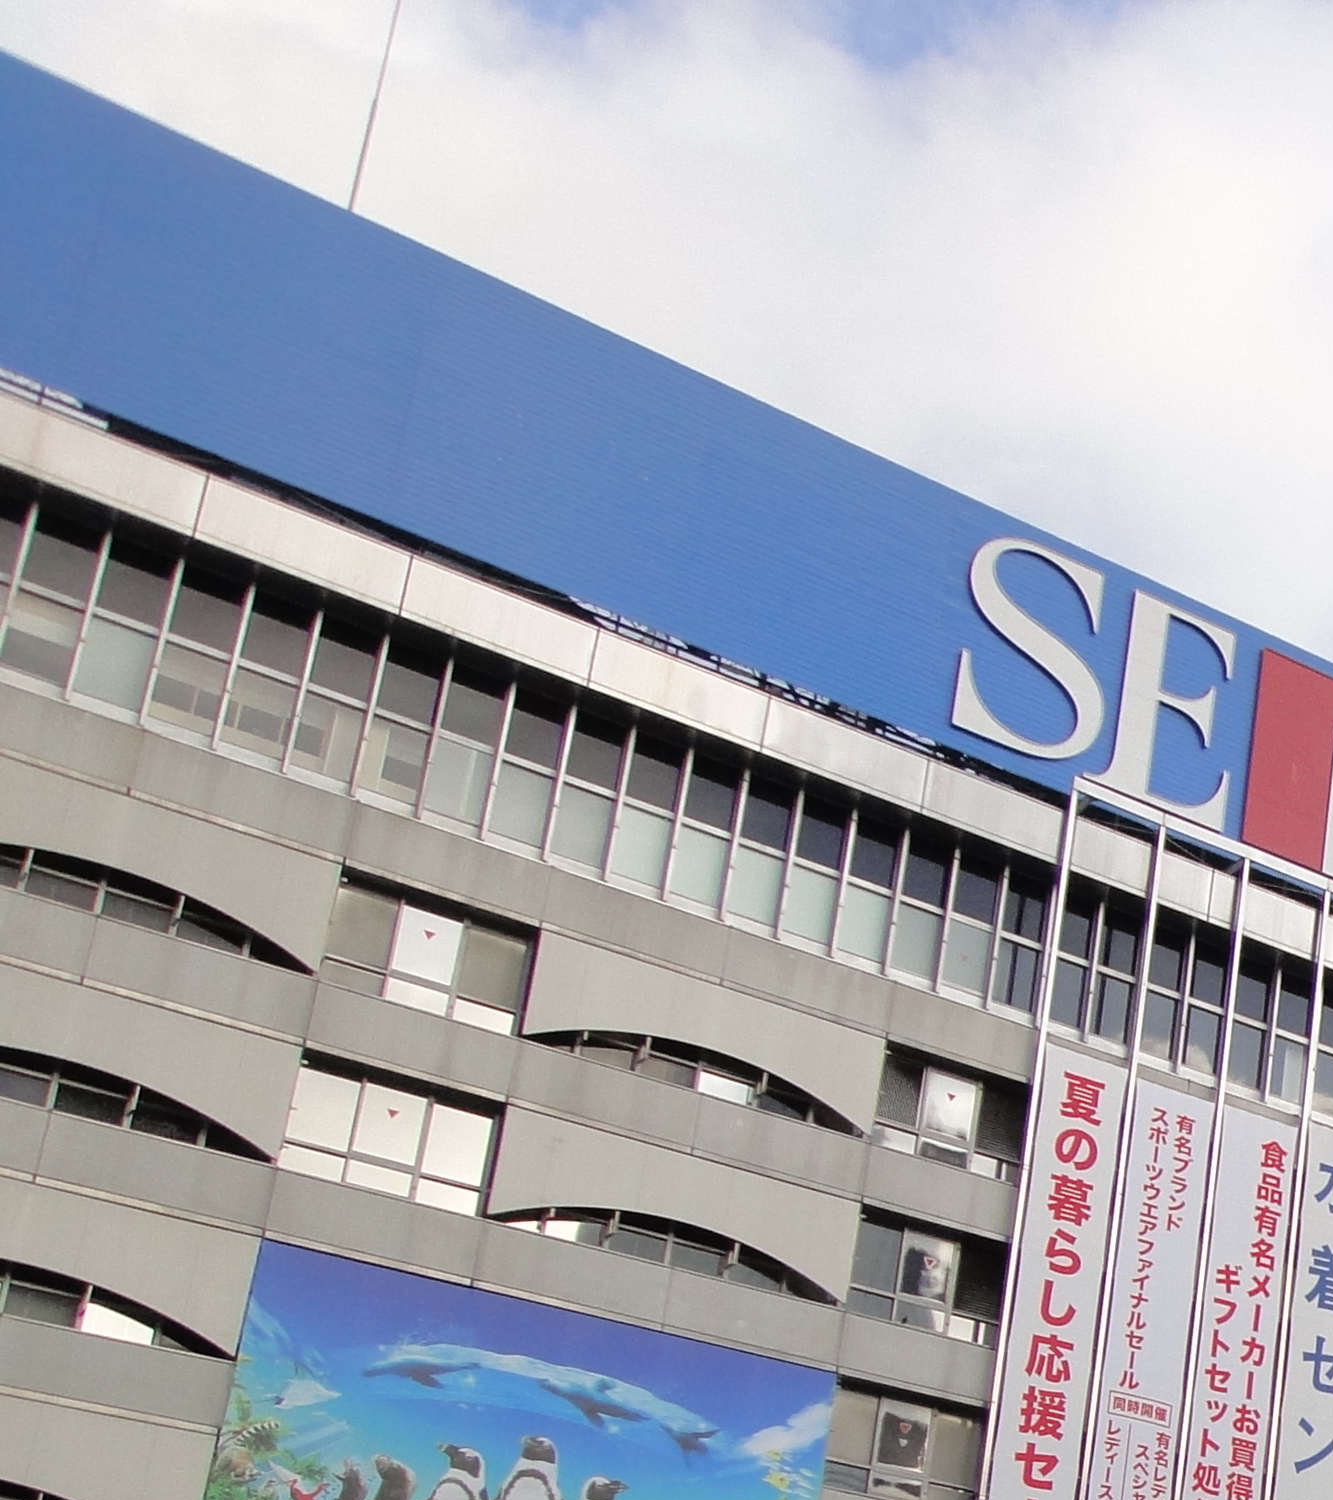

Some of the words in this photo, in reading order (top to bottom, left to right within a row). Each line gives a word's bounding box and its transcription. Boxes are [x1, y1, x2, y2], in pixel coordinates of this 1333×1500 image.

[1165, 1114, 1196, 1232] 有名ブランド
[1118, 1106, 1169, 1390] スポーツウエアファイナルセール
[1112, 1396, 1168, 1422] 同時開催
